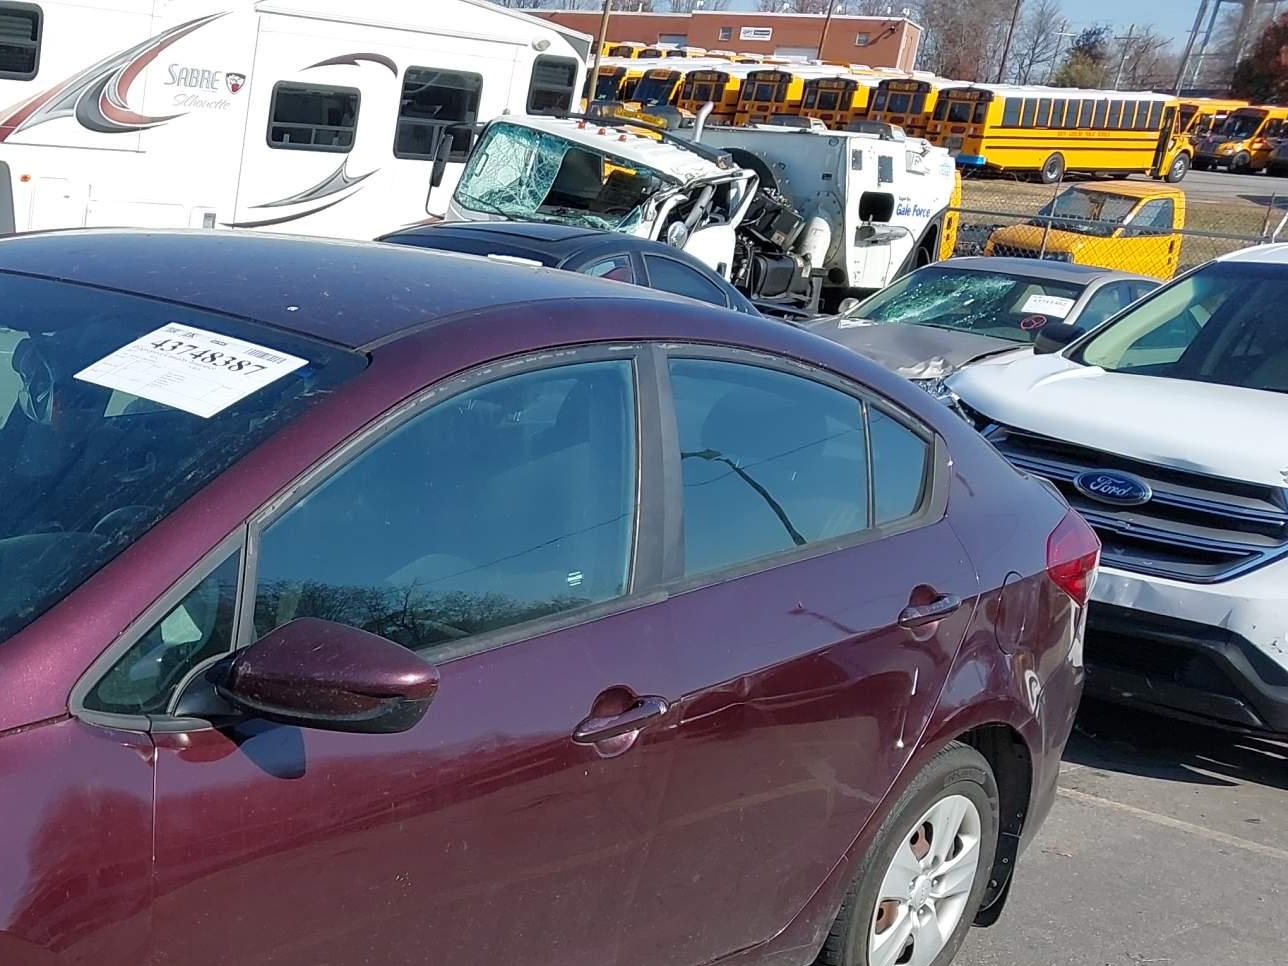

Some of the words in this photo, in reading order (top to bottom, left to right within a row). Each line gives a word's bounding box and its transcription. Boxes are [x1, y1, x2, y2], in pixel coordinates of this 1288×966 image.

[163, 63, 223, 90] SABRE
[896, 203, 912, 216] Gale
[912, 204, 931, 218] Force
[151, 339, 269, 375] 43748387
[1090, 475, 1133, 497] Ford
